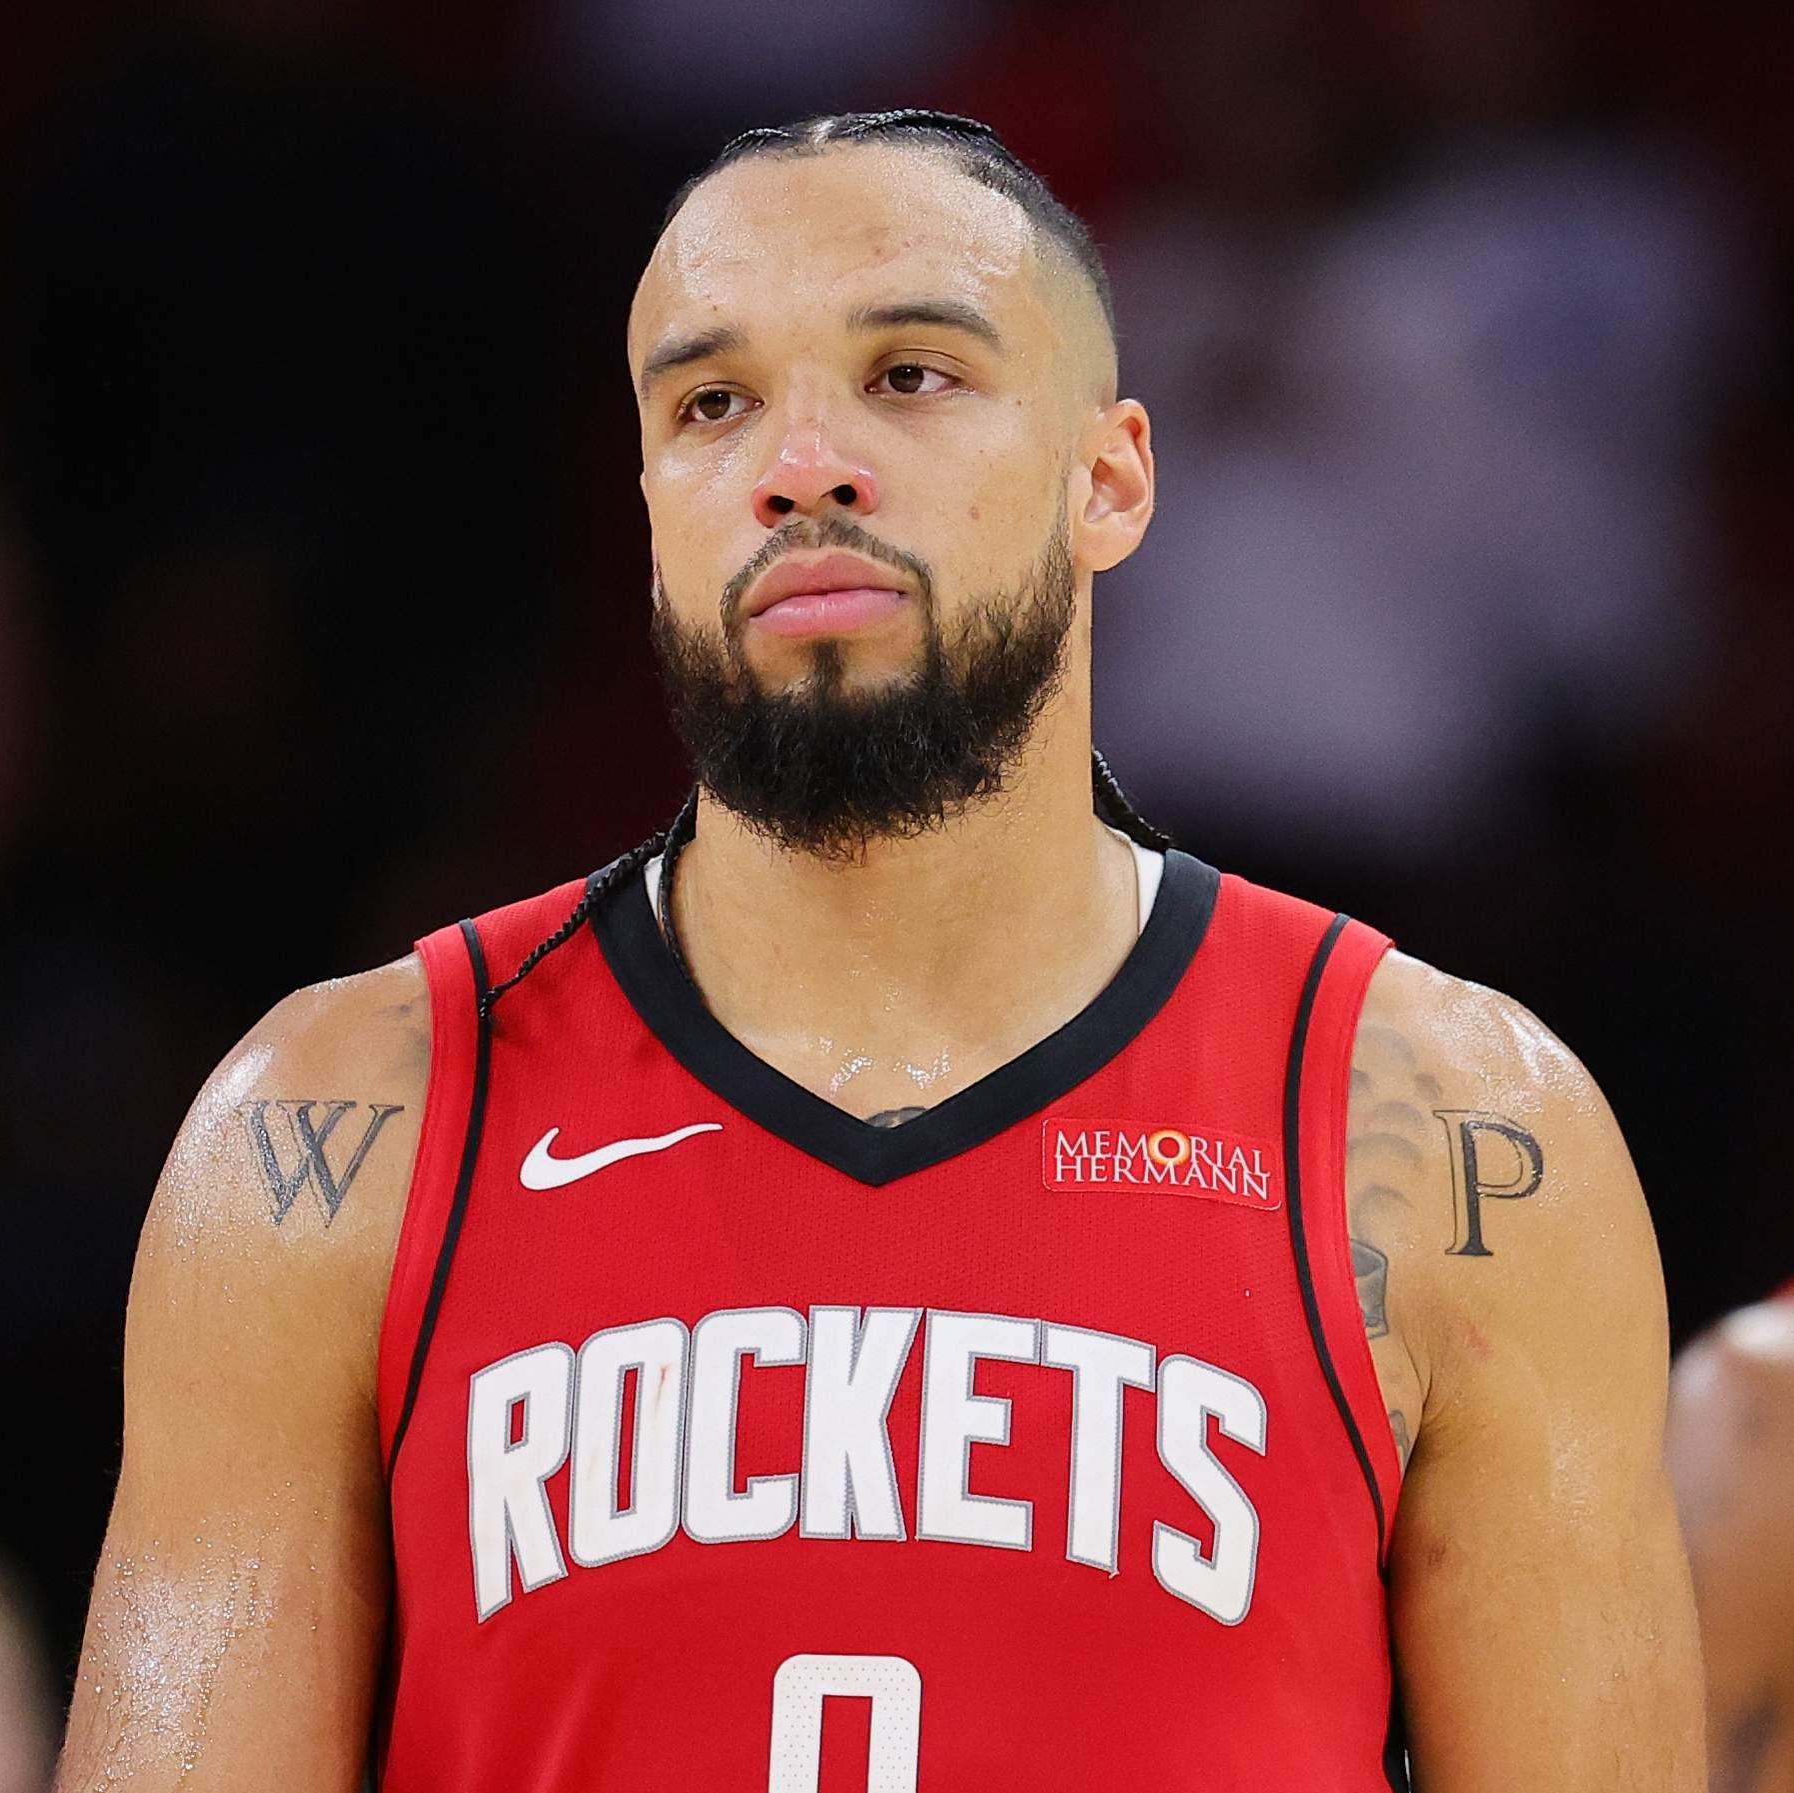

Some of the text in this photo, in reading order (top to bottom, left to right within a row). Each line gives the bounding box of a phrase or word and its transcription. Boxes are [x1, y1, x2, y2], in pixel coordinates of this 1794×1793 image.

[237, 1099, 405, 1228] W
[1054, 1128, 1271, 1178] MEMORIAL
[1054, 1154, 1271, 1201] HERMANN
[1432, 1109, 1544, 1256] P
[466, 1305, 1268, 1627] ROCKETS
